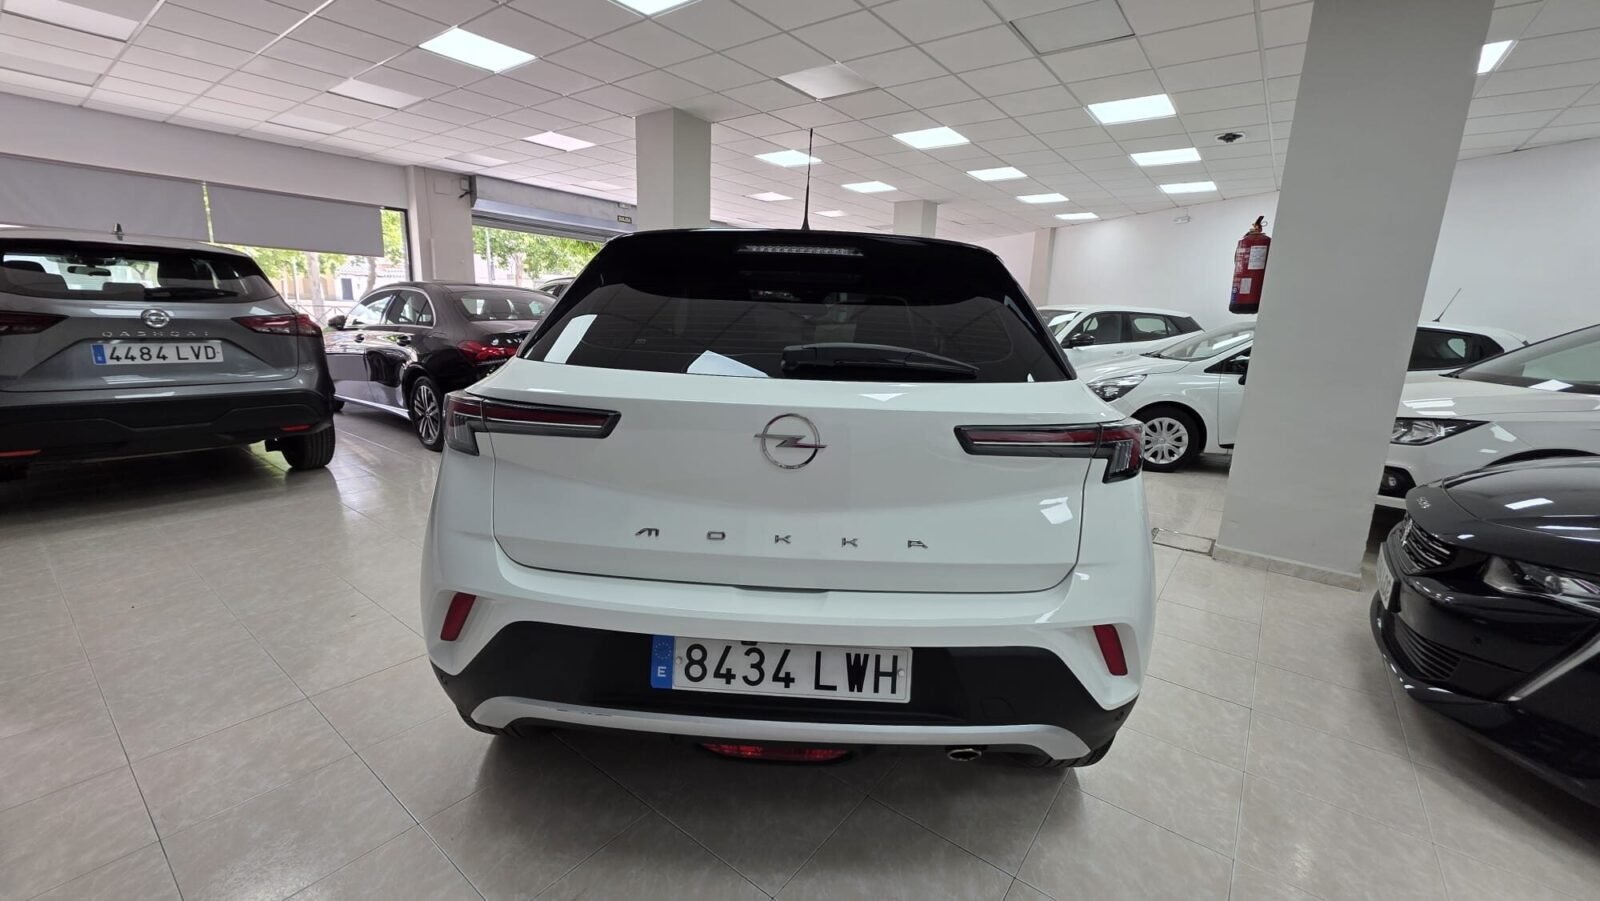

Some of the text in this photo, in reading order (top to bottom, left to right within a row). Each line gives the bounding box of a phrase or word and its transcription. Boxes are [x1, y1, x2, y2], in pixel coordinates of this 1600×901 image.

[109, 344, 217, 362] 4484 LVD
[634, 527, 929, 549] MOKKA
[657, 643, 899, 695] E 8434 LWH
